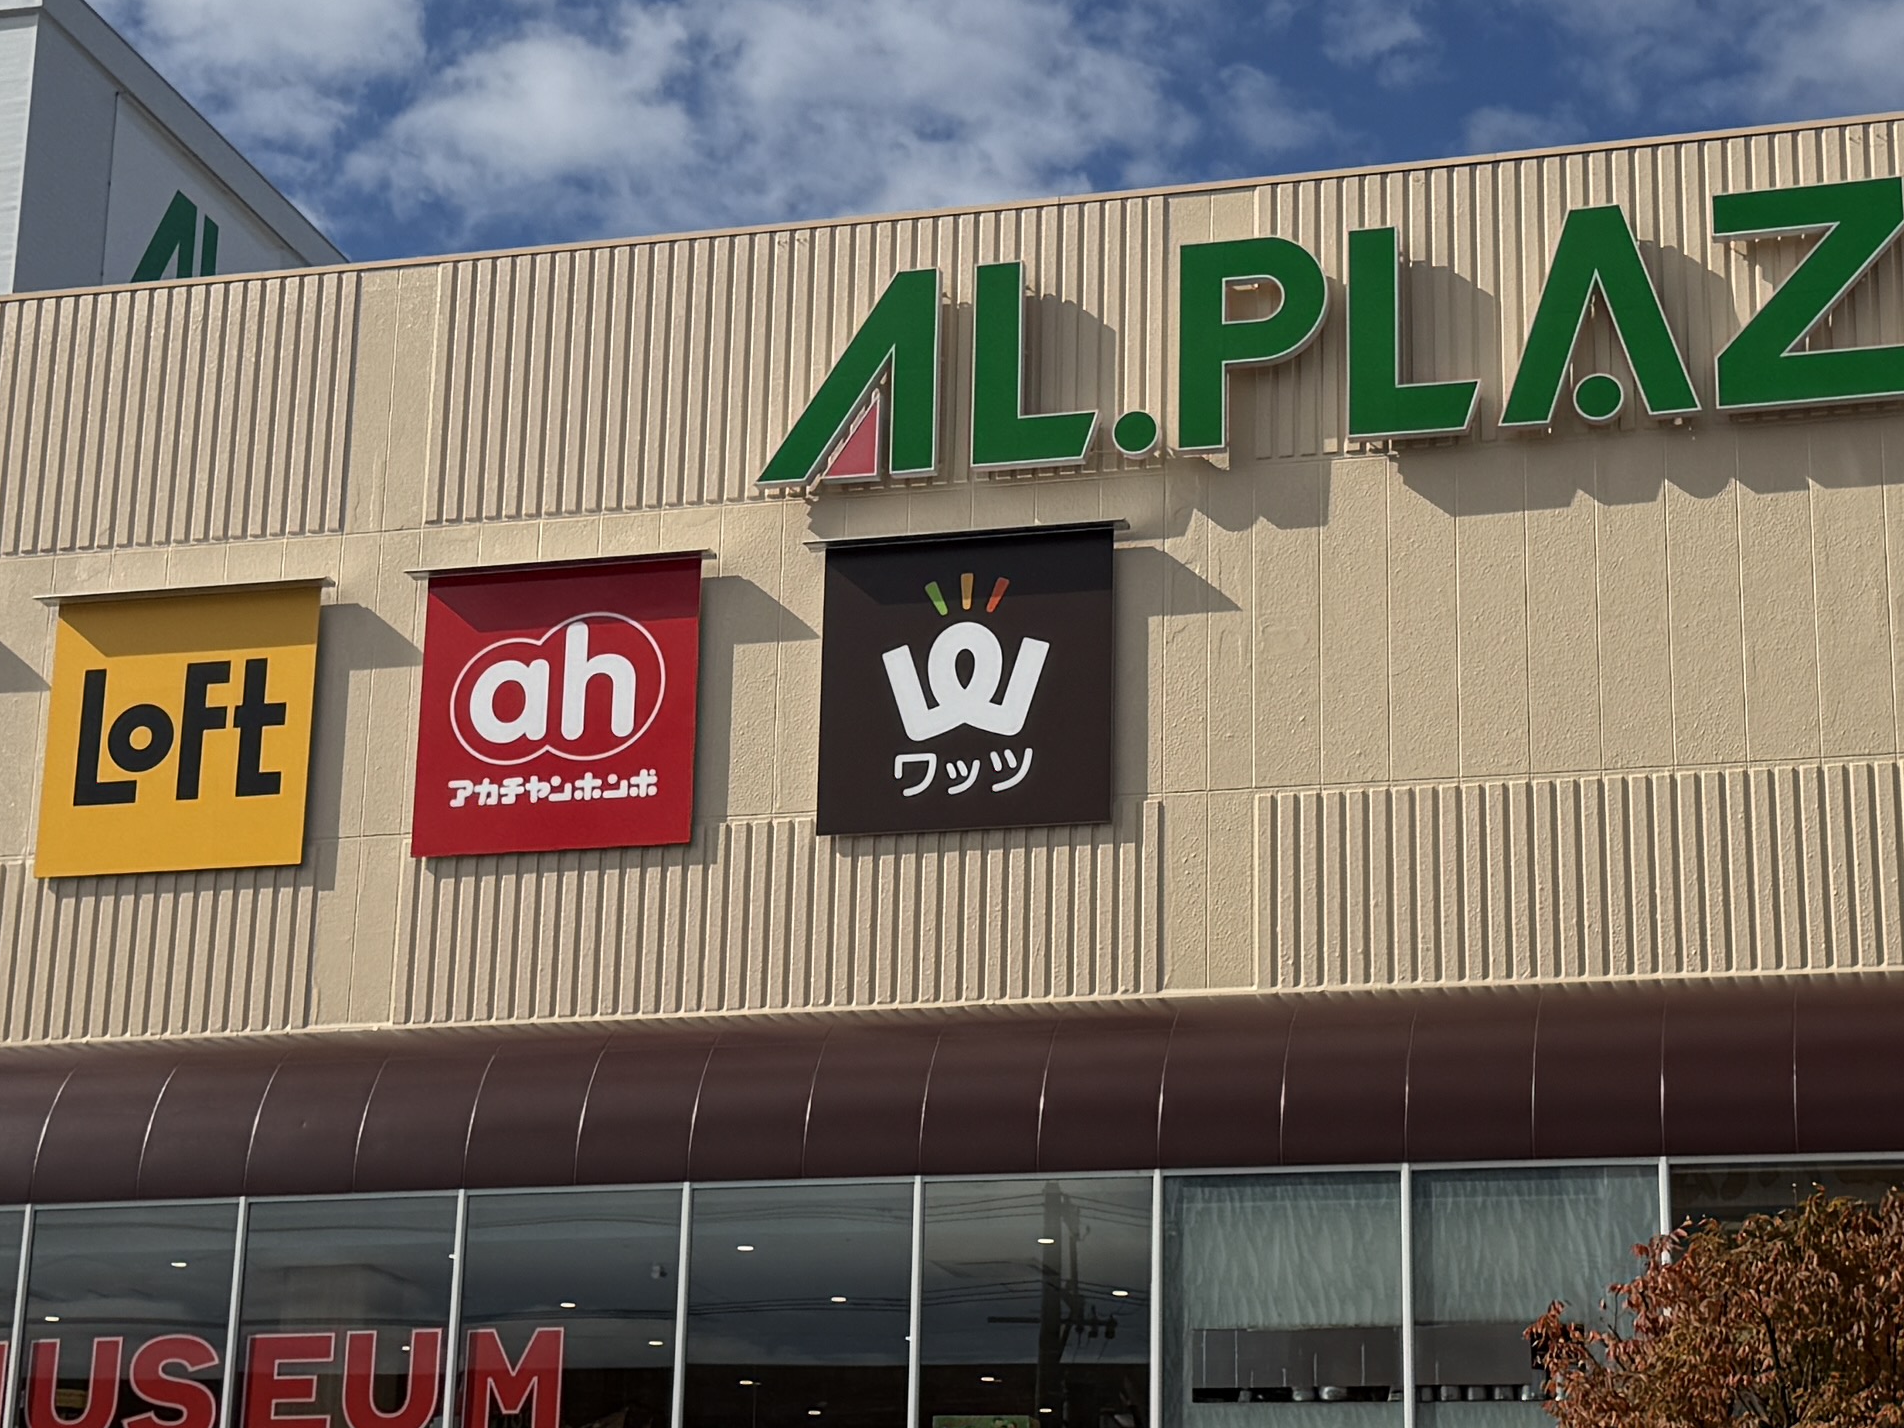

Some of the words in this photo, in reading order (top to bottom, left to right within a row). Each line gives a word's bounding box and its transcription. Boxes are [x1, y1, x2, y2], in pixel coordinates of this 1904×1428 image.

[470, 611, 637, 743] ah
[895, 745, 1034, 798] ワッツ
